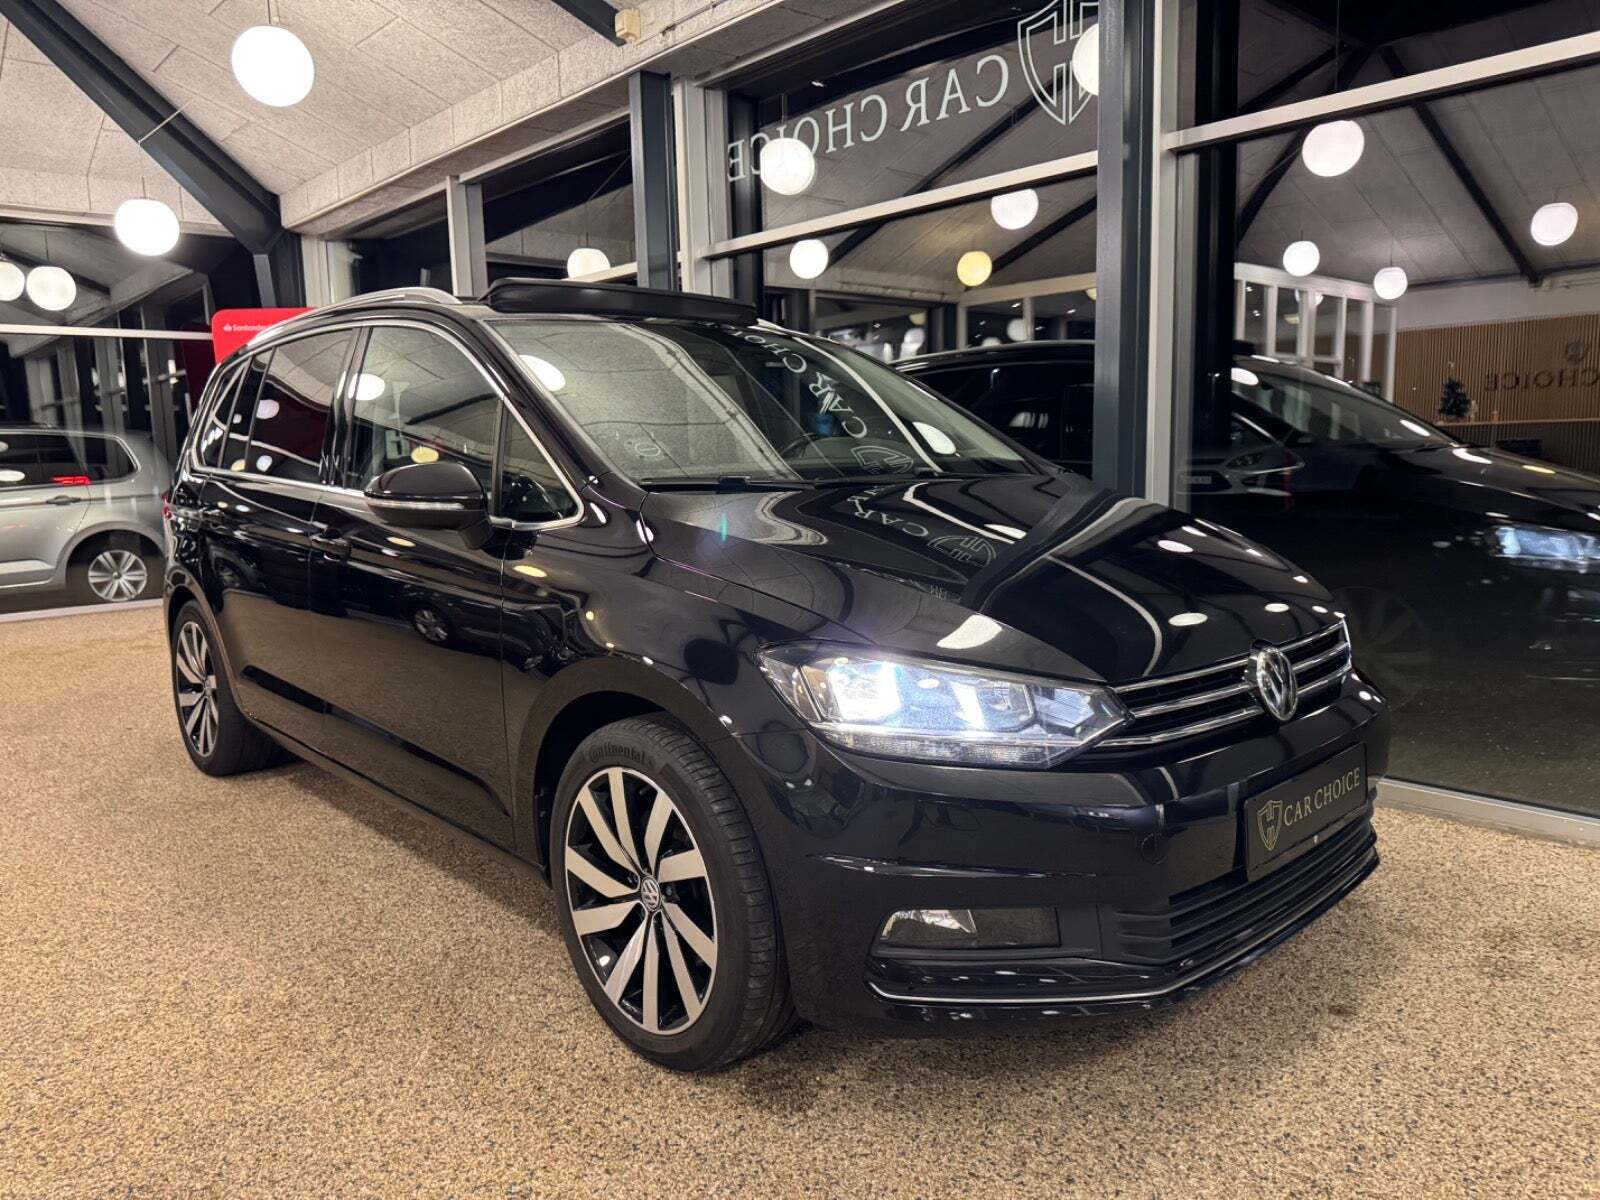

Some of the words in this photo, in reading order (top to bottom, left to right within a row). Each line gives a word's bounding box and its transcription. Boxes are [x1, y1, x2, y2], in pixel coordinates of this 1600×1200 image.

[589, 741, 647, 766] Continental
[1284, 796, 1312, 826] CAR
[1314, 767, 1361, 809] CHOICE
